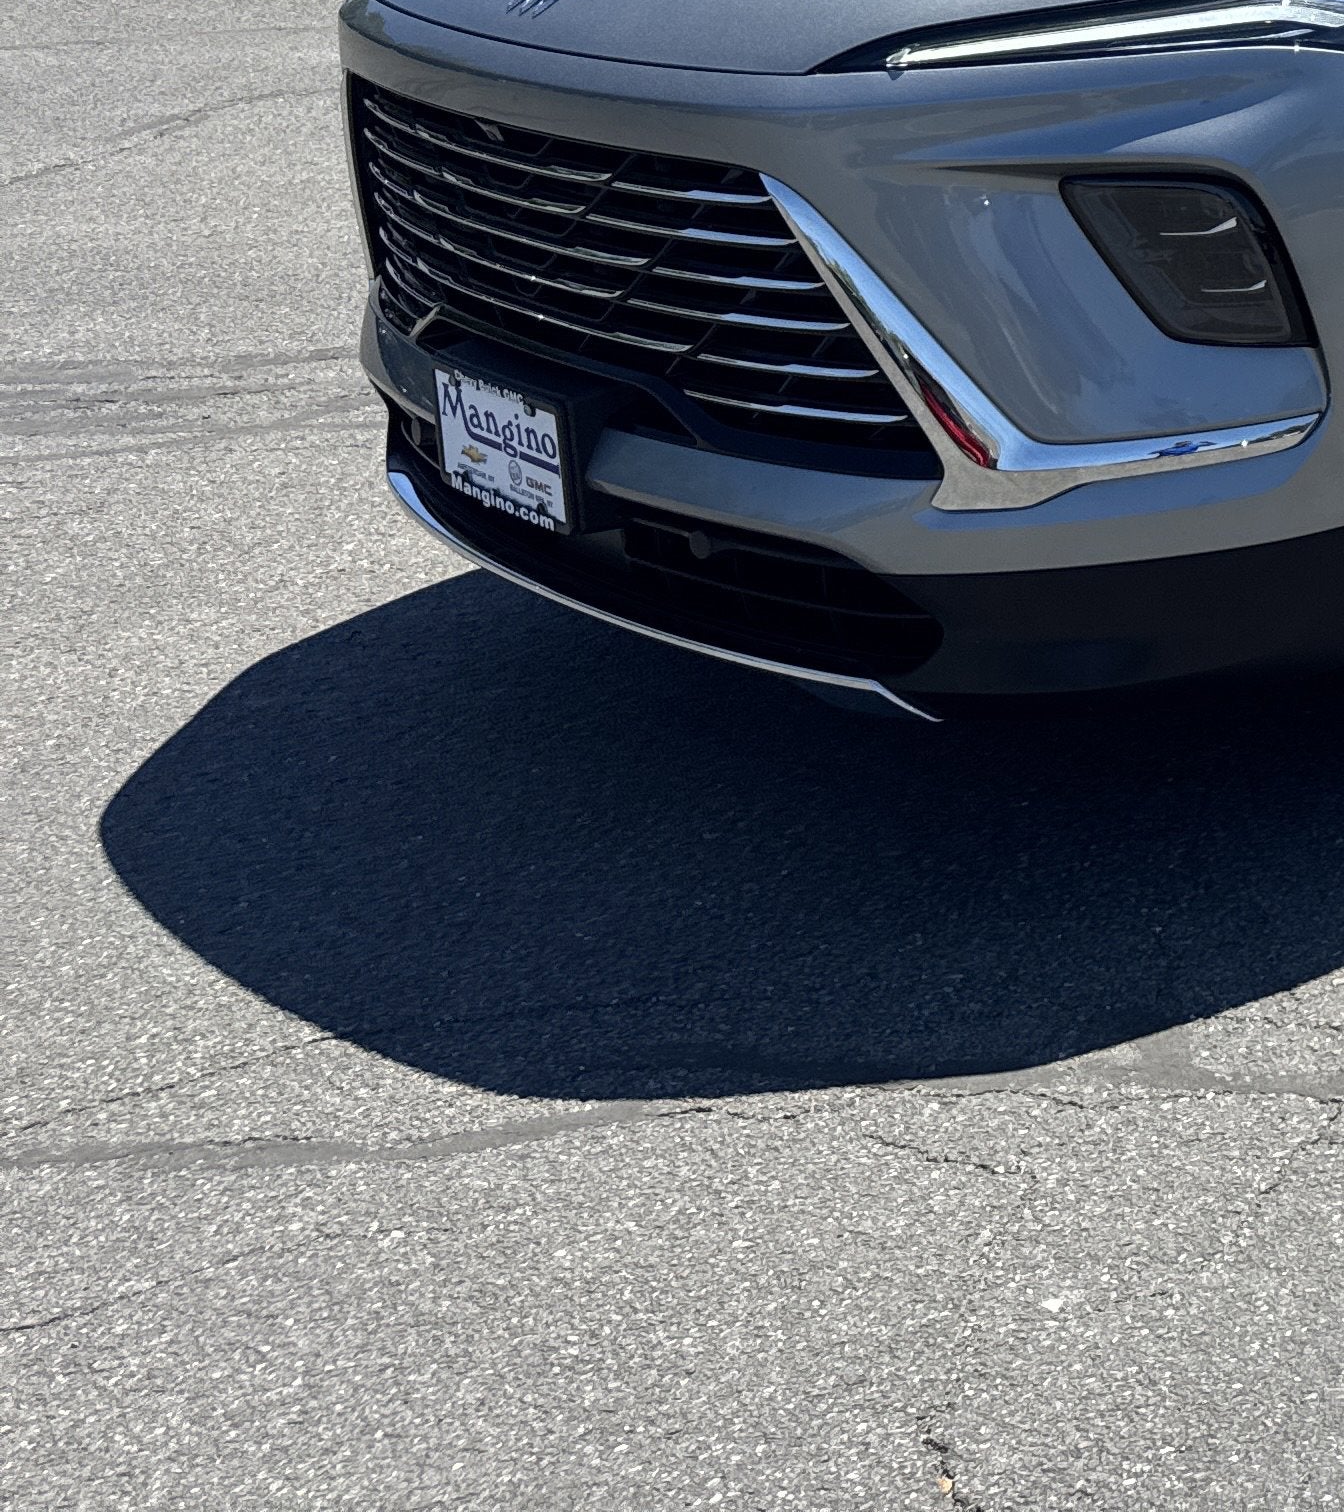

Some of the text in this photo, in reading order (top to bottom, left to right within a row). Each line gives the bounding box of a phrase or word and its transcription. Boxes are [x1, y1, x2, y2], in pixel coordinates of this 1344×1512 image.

[503, 388, 524, 405] GMC
[441, 381, 557, 459] Mangino
[451, 472, 555, 532] Mangino.com
[526, 475, 553, 497] GMC
